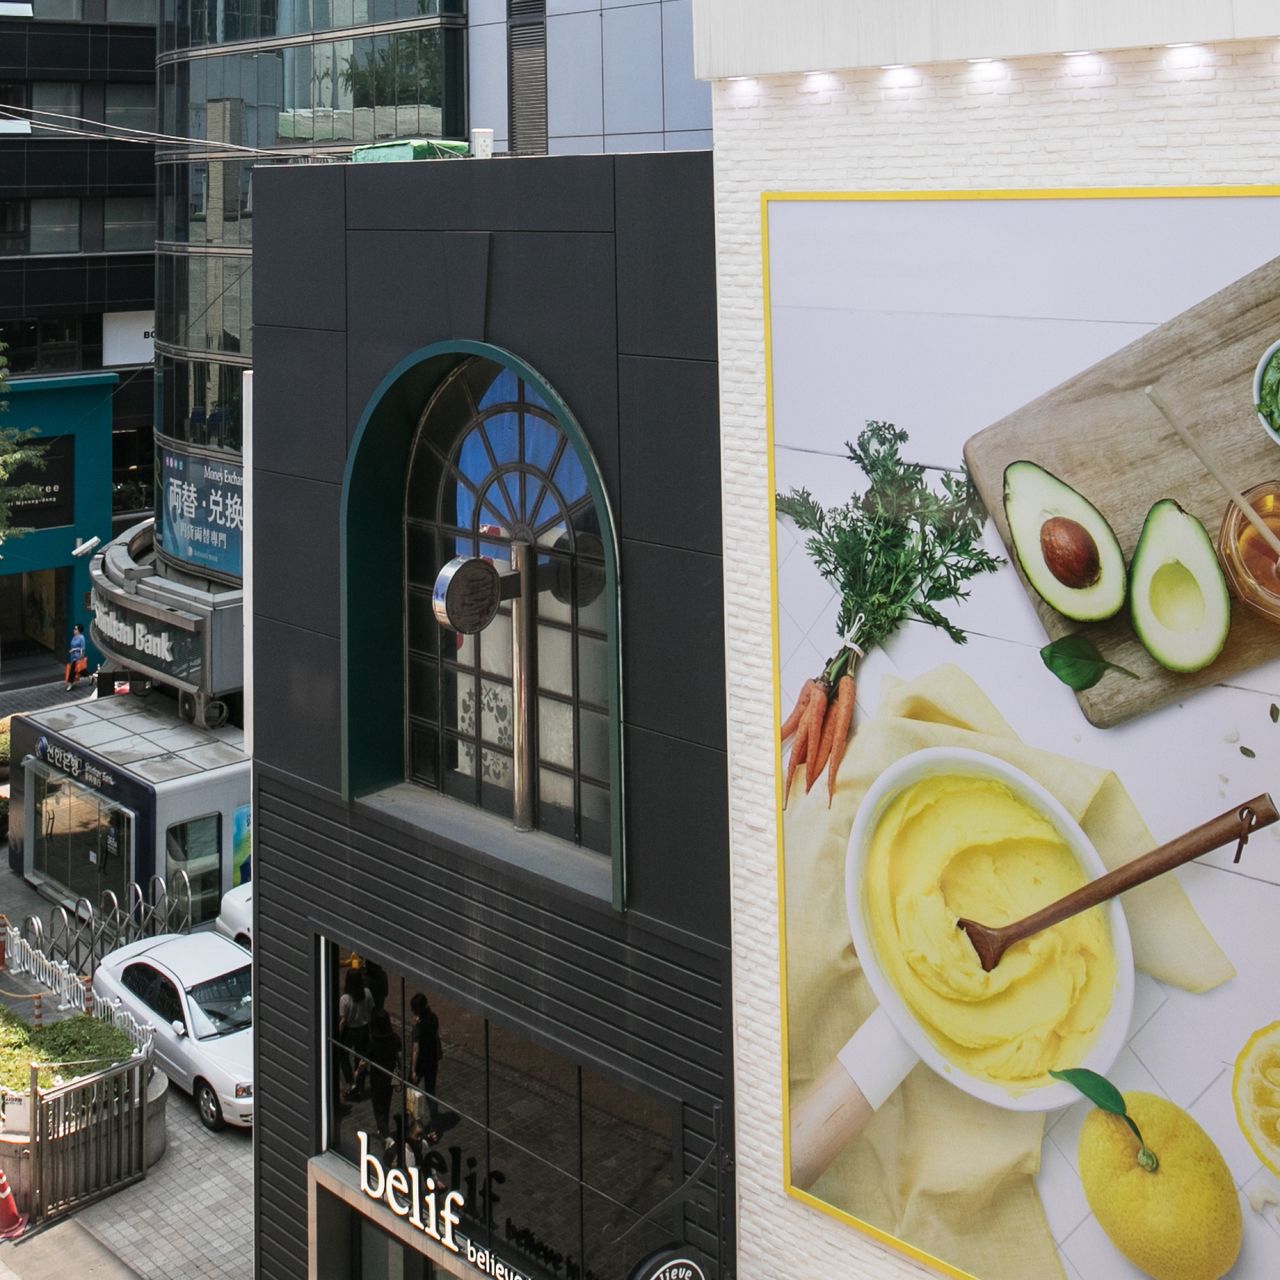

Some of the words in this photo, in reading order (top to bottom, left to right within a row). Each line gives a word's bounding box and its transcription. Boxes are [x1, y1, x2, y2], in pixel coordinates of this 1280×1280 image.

[135, 622, 174, 662] Bank
[47, 743, 82, 776] 신한은행
[357, 1131, 465, 1253] belif
